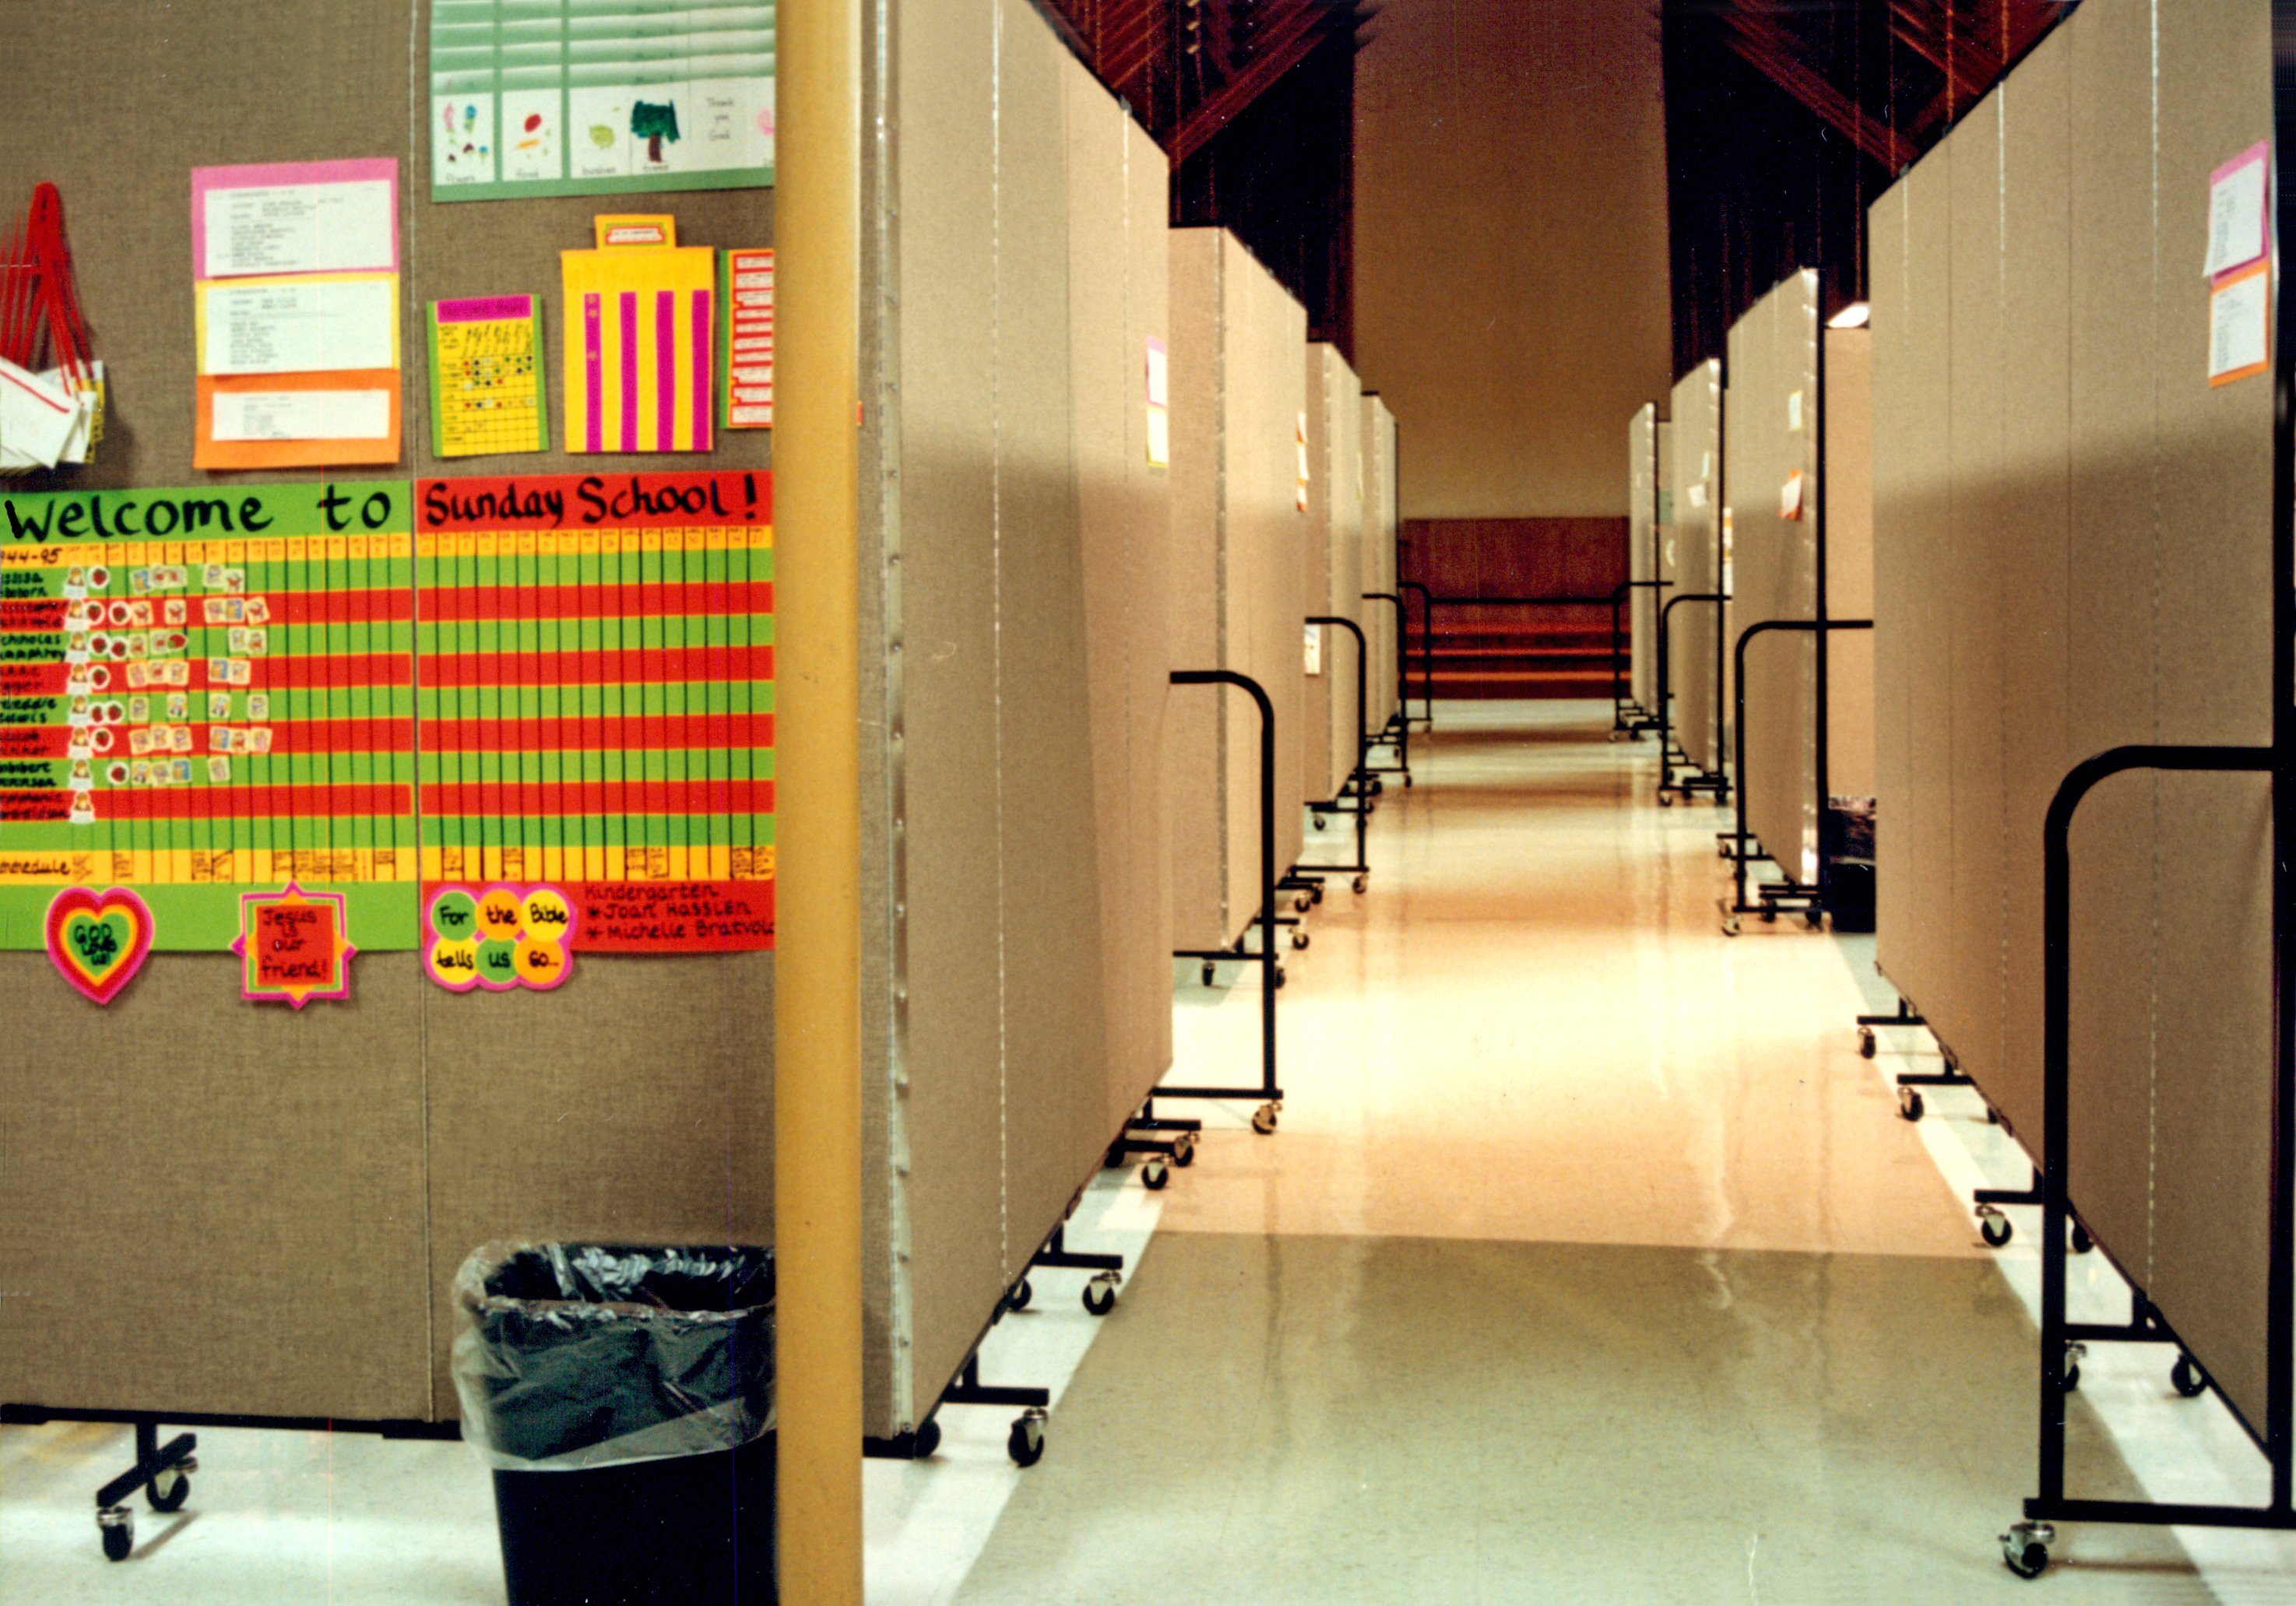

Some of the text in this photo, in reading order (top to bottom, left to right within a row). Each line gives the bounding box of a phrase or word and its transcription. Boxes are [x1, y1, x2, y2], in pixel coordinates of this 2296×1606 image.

[5, 484, 390, 543] Welcome to
[425, 483, 564, 529] Sunday
[263, 908, 318, 926] Jesus
[440, 902, 568, 926] For the Bible
[437, 950, 474, 970] tells
[488, 952, 511, 968] us
